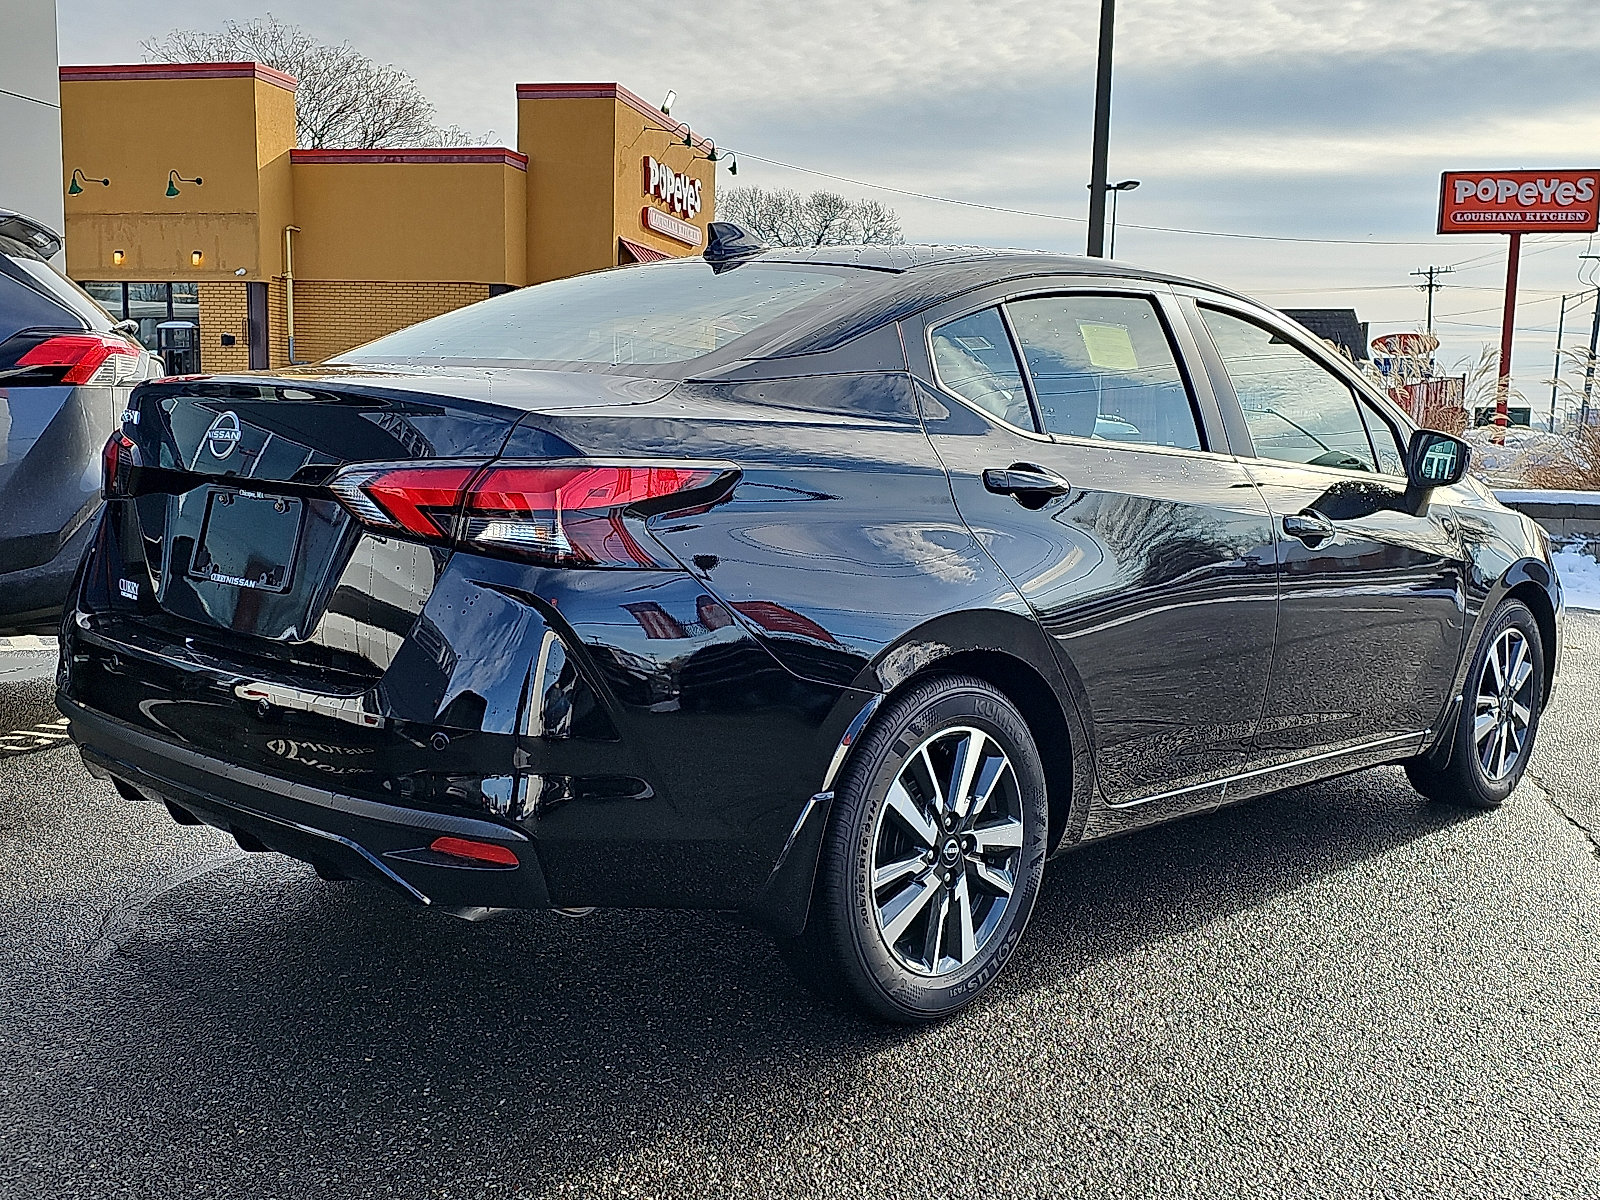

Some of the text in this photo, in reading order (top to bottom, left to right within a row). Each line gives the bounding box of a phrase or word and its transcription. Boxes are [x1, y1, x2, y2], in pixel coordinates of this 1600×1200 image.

[1455, 212, 1586, 222] LOUISIANA KITCHEN
[208, 429, 241, 441] NISSAN
[225, 575, 256, 588] NISSAN
[974, 698, 1023, 746] KUMHO
[967, 928, 1018, 993] SOLUS
[949, 983, 967, 998] TA31
